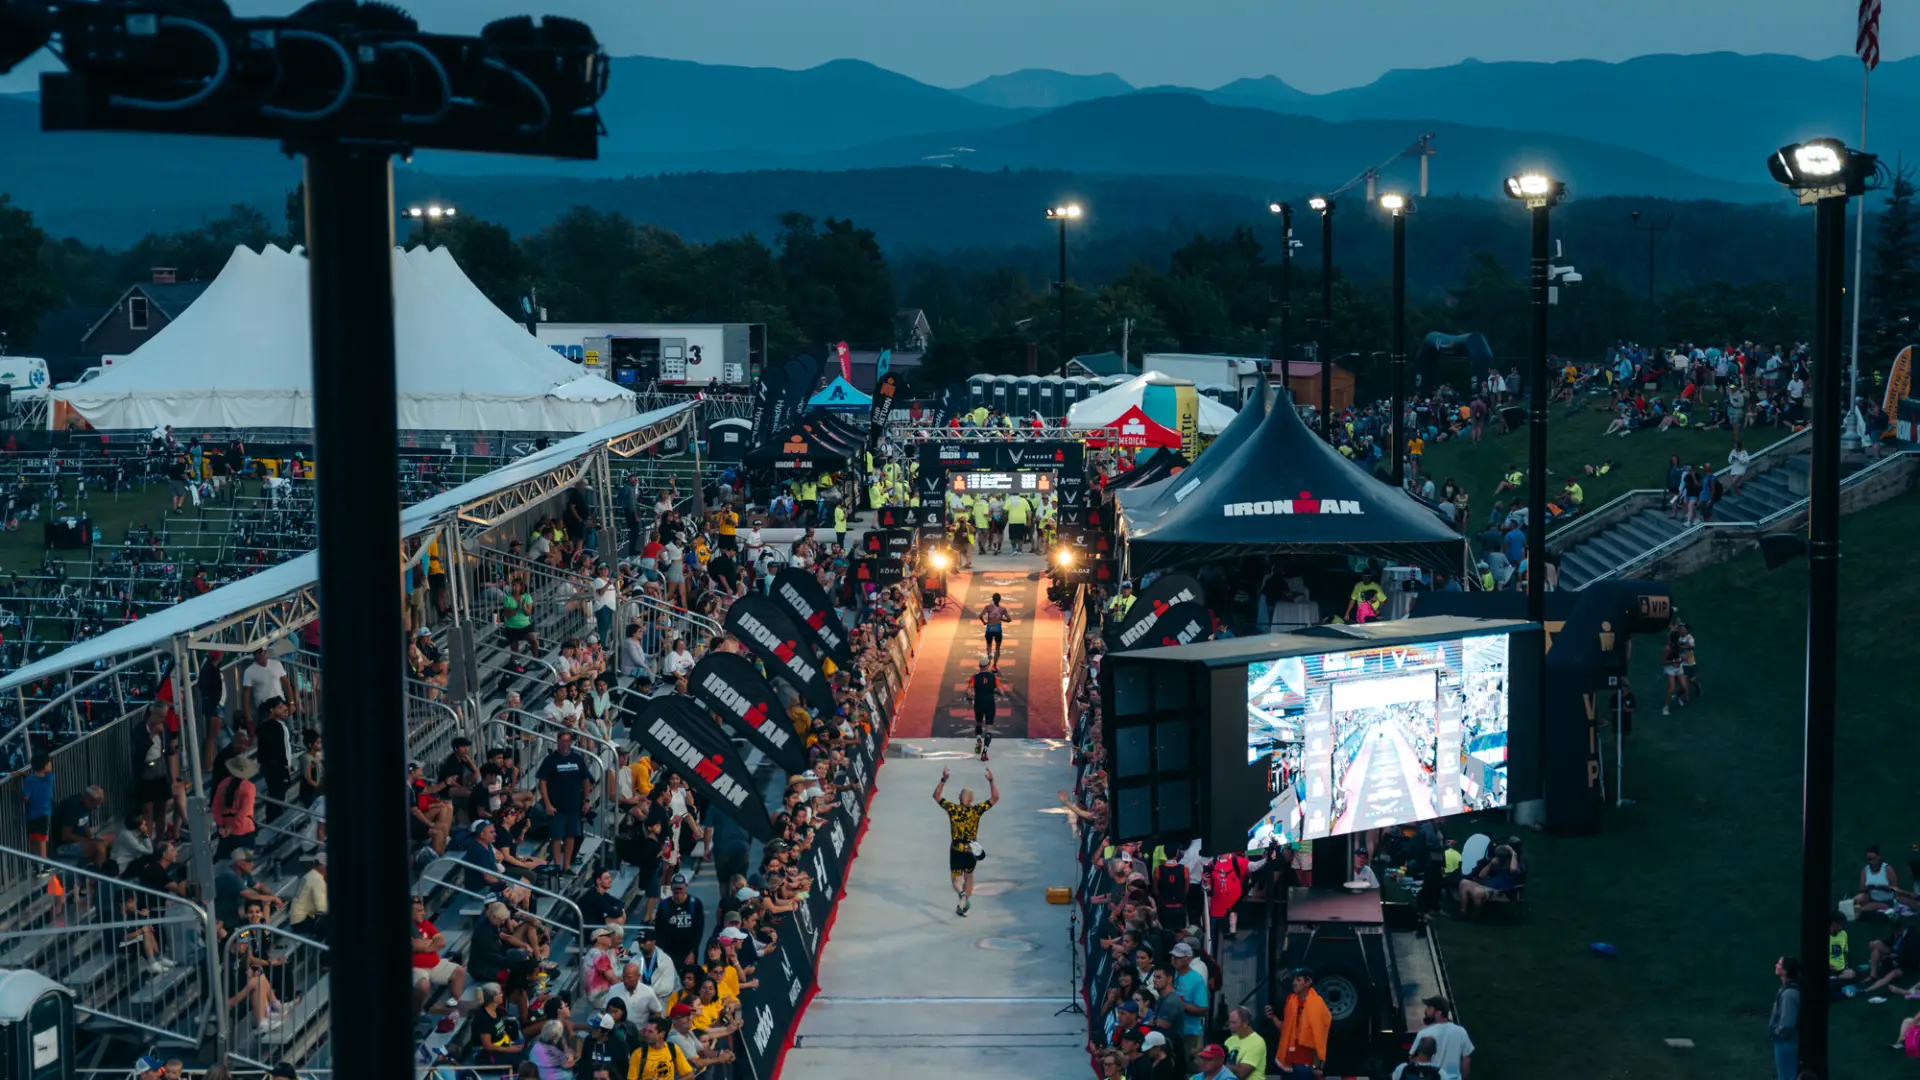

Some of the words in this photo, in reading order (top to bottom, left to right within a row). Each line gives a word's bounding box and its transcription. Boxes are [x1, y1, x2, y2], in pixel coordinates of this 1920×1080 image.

[689, 345, 702, 365] 3
[877, 397, 892, 425] RETURN
[1118, 436, 1147, 446] MEDICAL
[1182, 413, 1192, 460] THLETIC
[775, 458, 813, 469] IRONMAN
[1223, 491, 1364, 517] IRONMAN
[780, 582, 841, 650] IRONMAN
[1120, 588, 1195, 647] IRONMAN
[1651, 601, 1669, 613] VIP
[737, 612, 816, 684] IRONMAN
[702, 672, 790, 750] IRONMAN
[648, 717, 749, 808] IRONMAN
[1583, 694, 1598, 788] VIP
